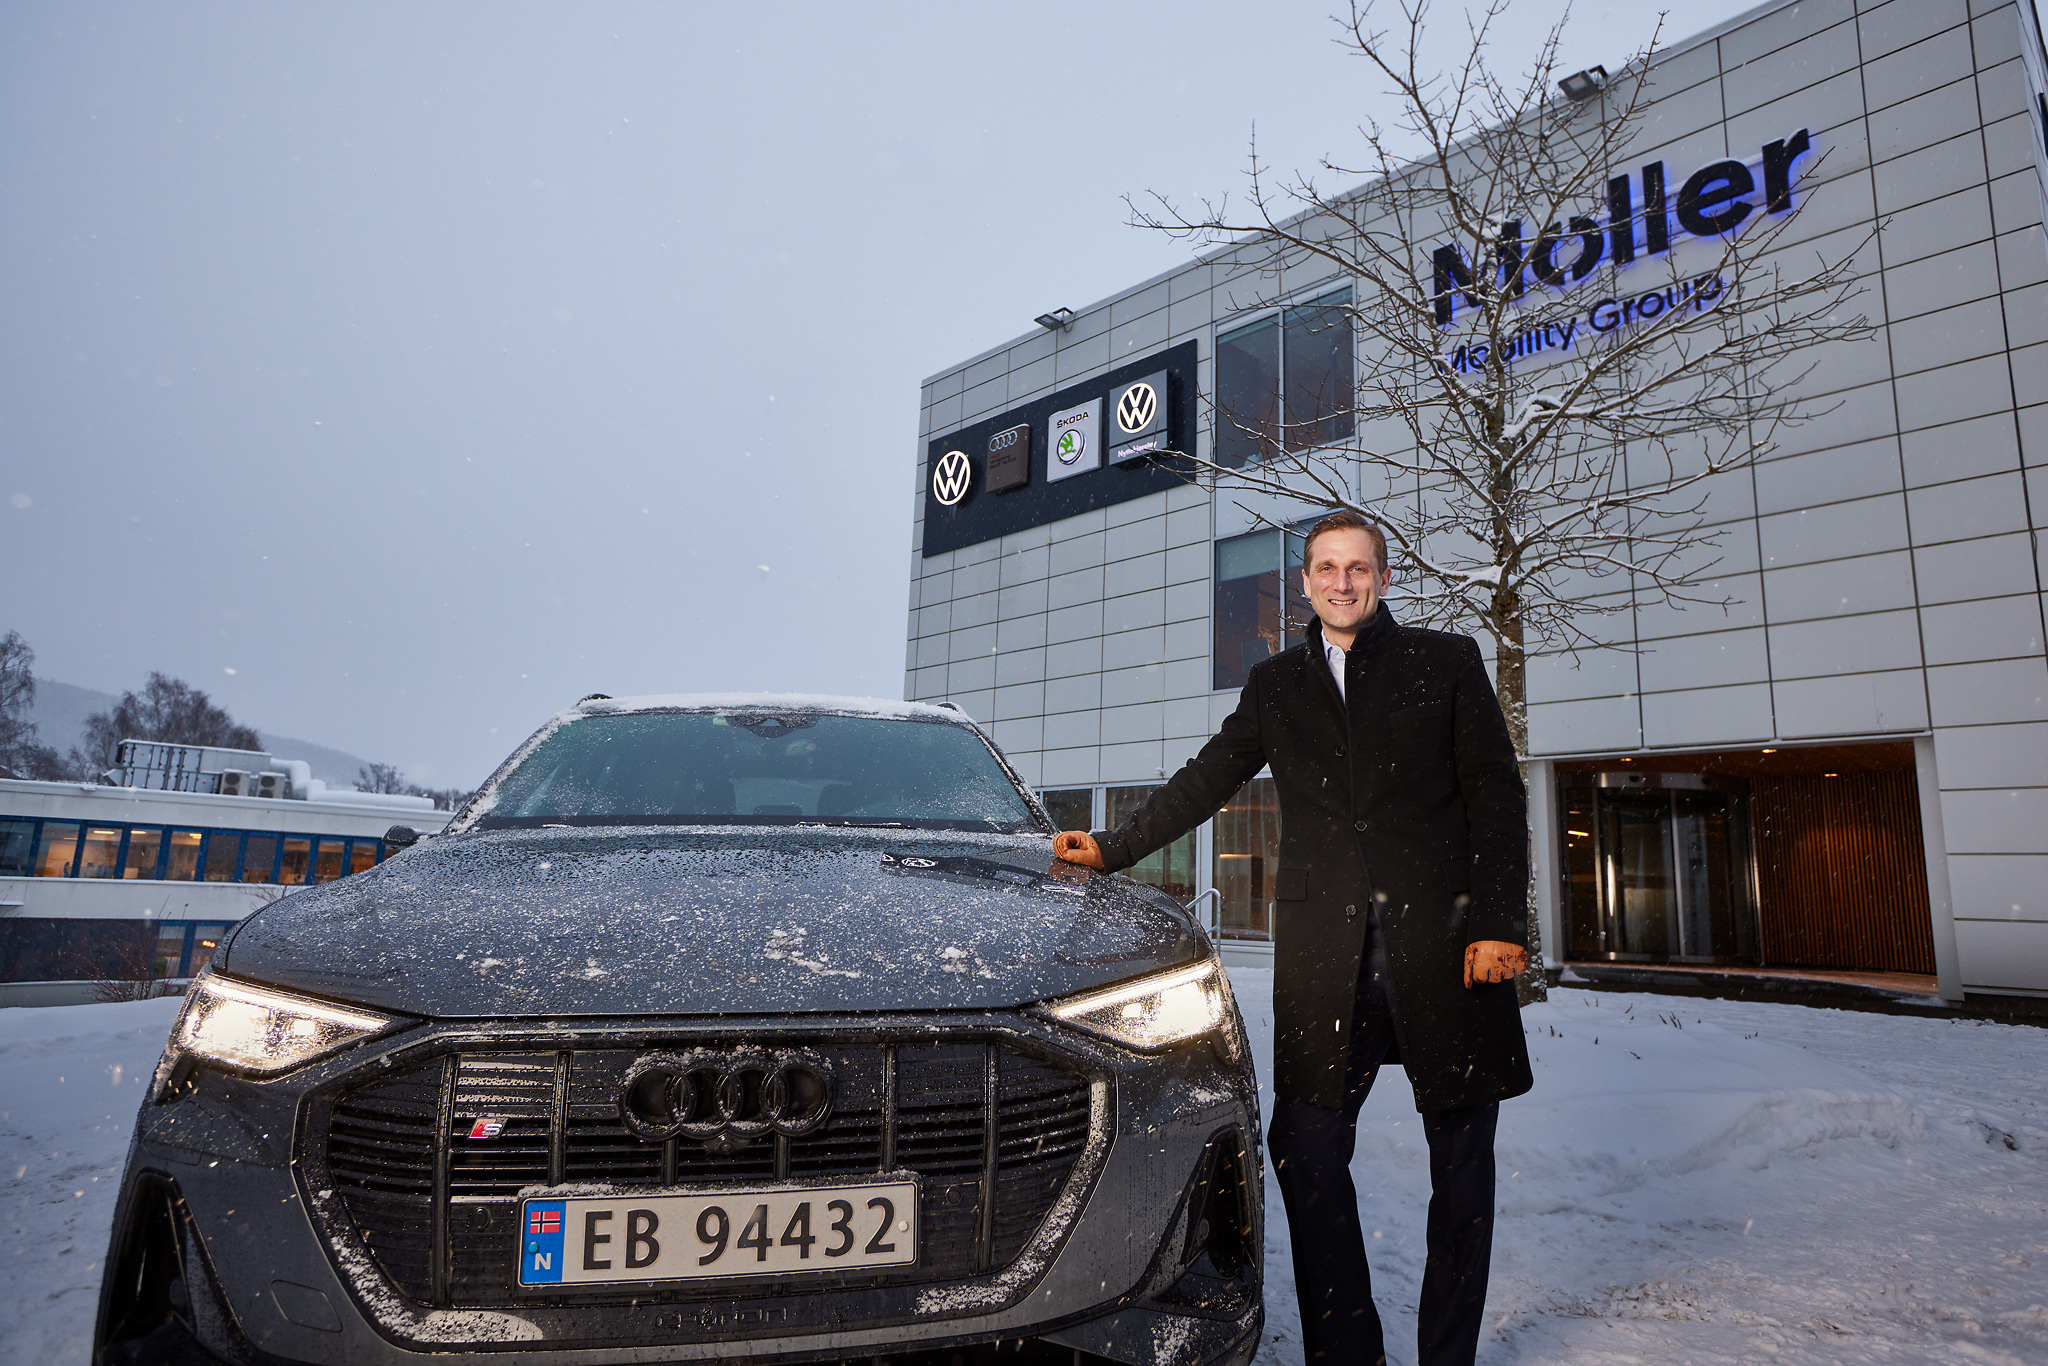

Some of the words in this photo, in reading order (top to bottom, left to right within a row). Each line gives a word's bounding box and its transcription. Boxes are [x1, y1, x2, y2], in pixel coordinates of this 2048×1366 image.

[1588, 272, 1722, 334] Group
[534, 1252, 552, 1271] N
[582, 1208, 661, 1271] EB
[696, 1196, 896, 1266] 94432
